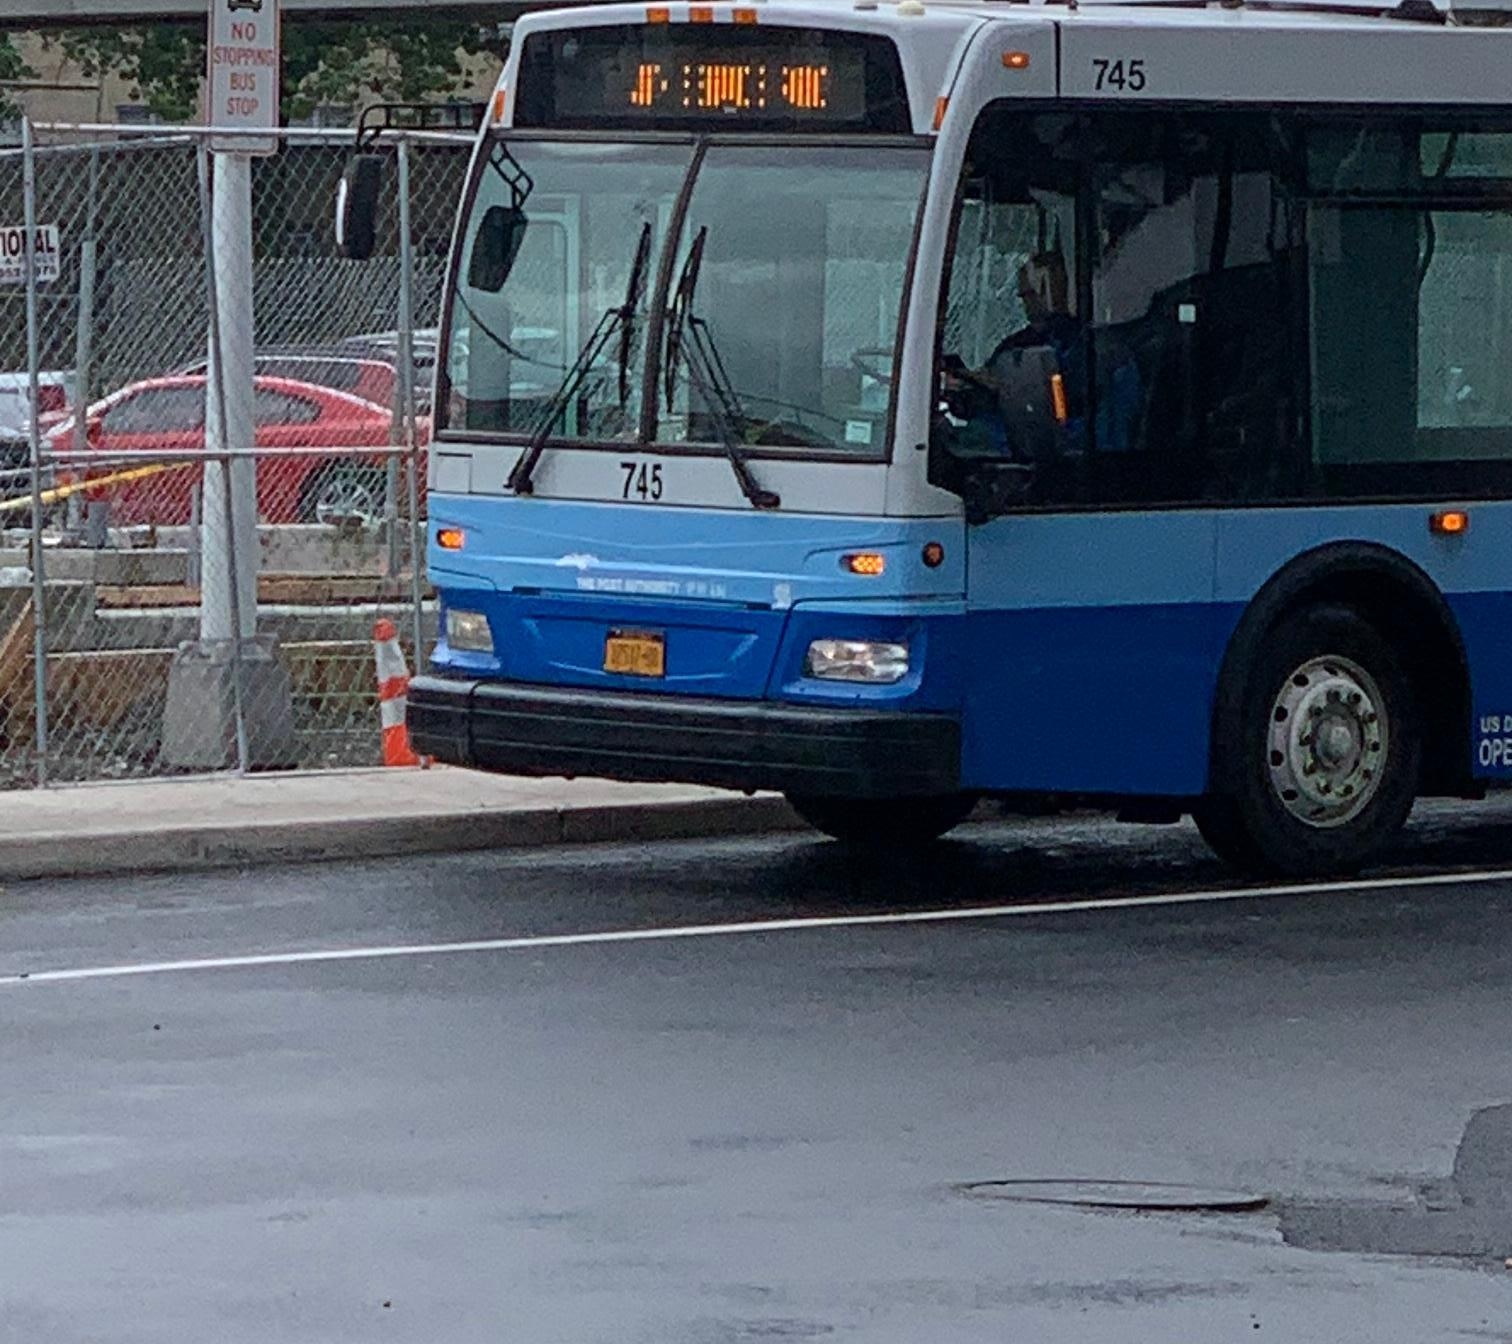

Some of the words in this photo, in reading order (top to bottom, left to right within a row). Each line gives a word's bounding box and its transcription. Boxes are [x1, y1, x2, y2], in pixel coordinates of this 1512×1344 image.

[231, 22, 256, 42] NO
[213, 46, 275, 66] STOPPING
[230, 72, 256, 91] BUS
[1093, 59, 1145, 91] 745
[227, 97, 259, 115] STOP
[620, 462, 662, 500] 745
[1480, 716, 1500, 733] US
